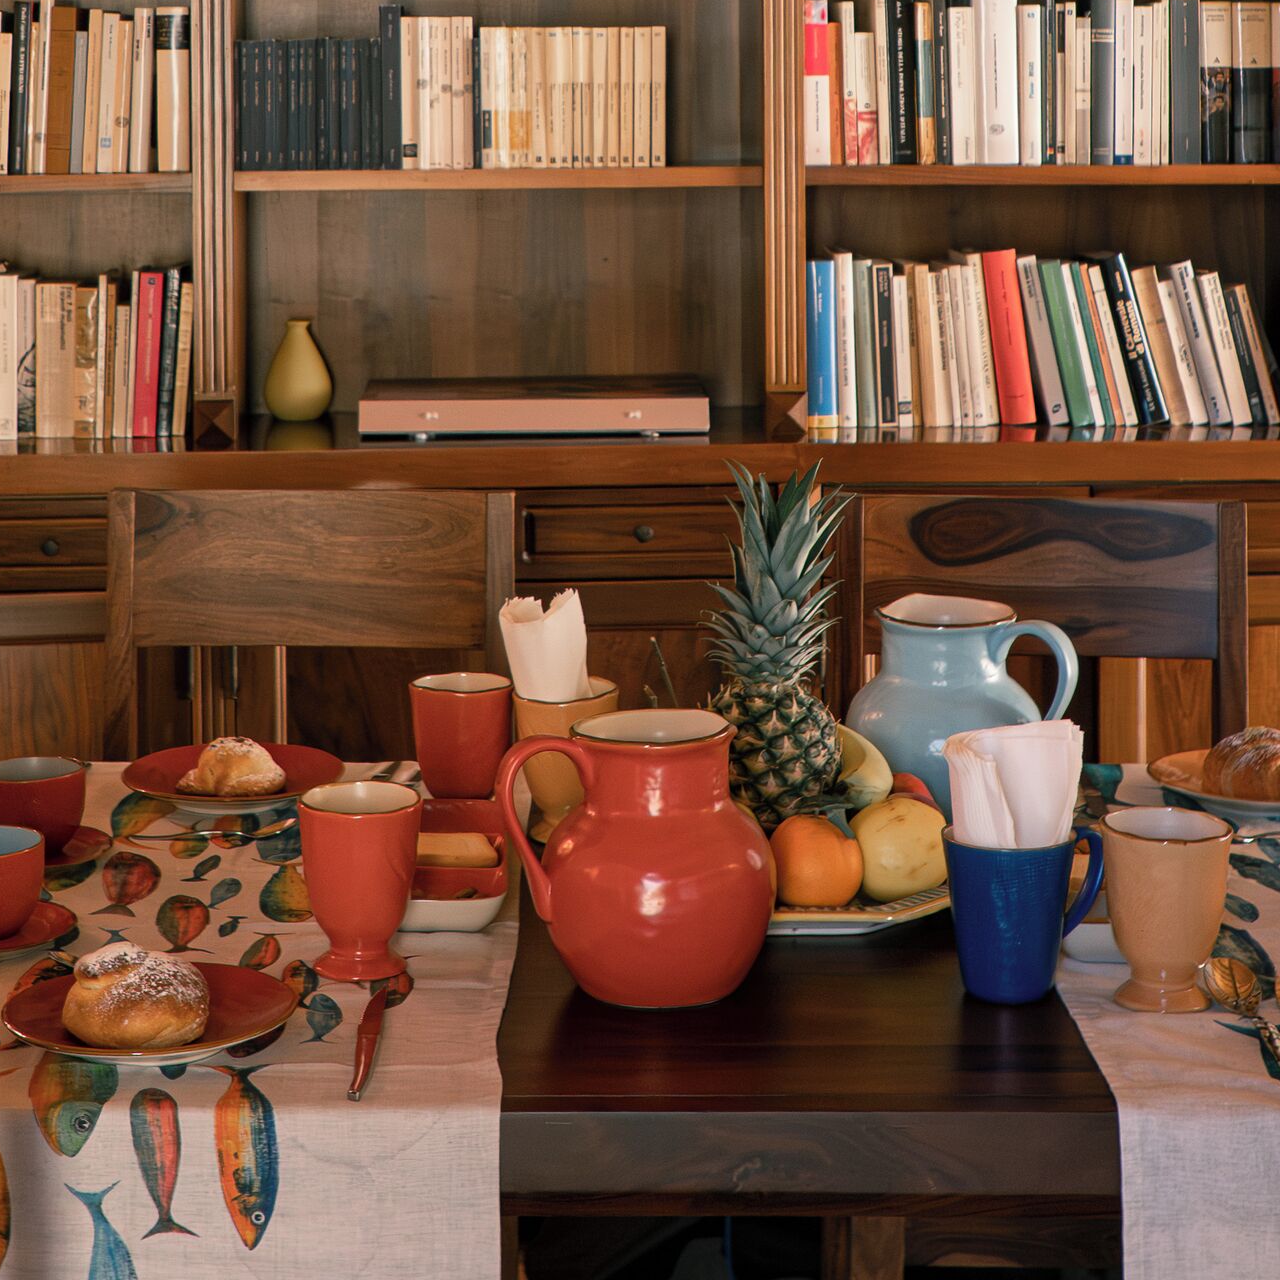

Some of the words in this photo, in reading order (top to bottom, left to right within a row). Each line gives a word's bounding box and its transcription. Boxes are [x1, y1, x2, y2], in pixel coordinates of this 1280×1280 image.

[1116, 300, 1135, 349] Carnevale
[1125, 300, 1142, 342] Romans
[1126, 351, 1137, 360] Il
[1134, 343, 1145, 354] di
